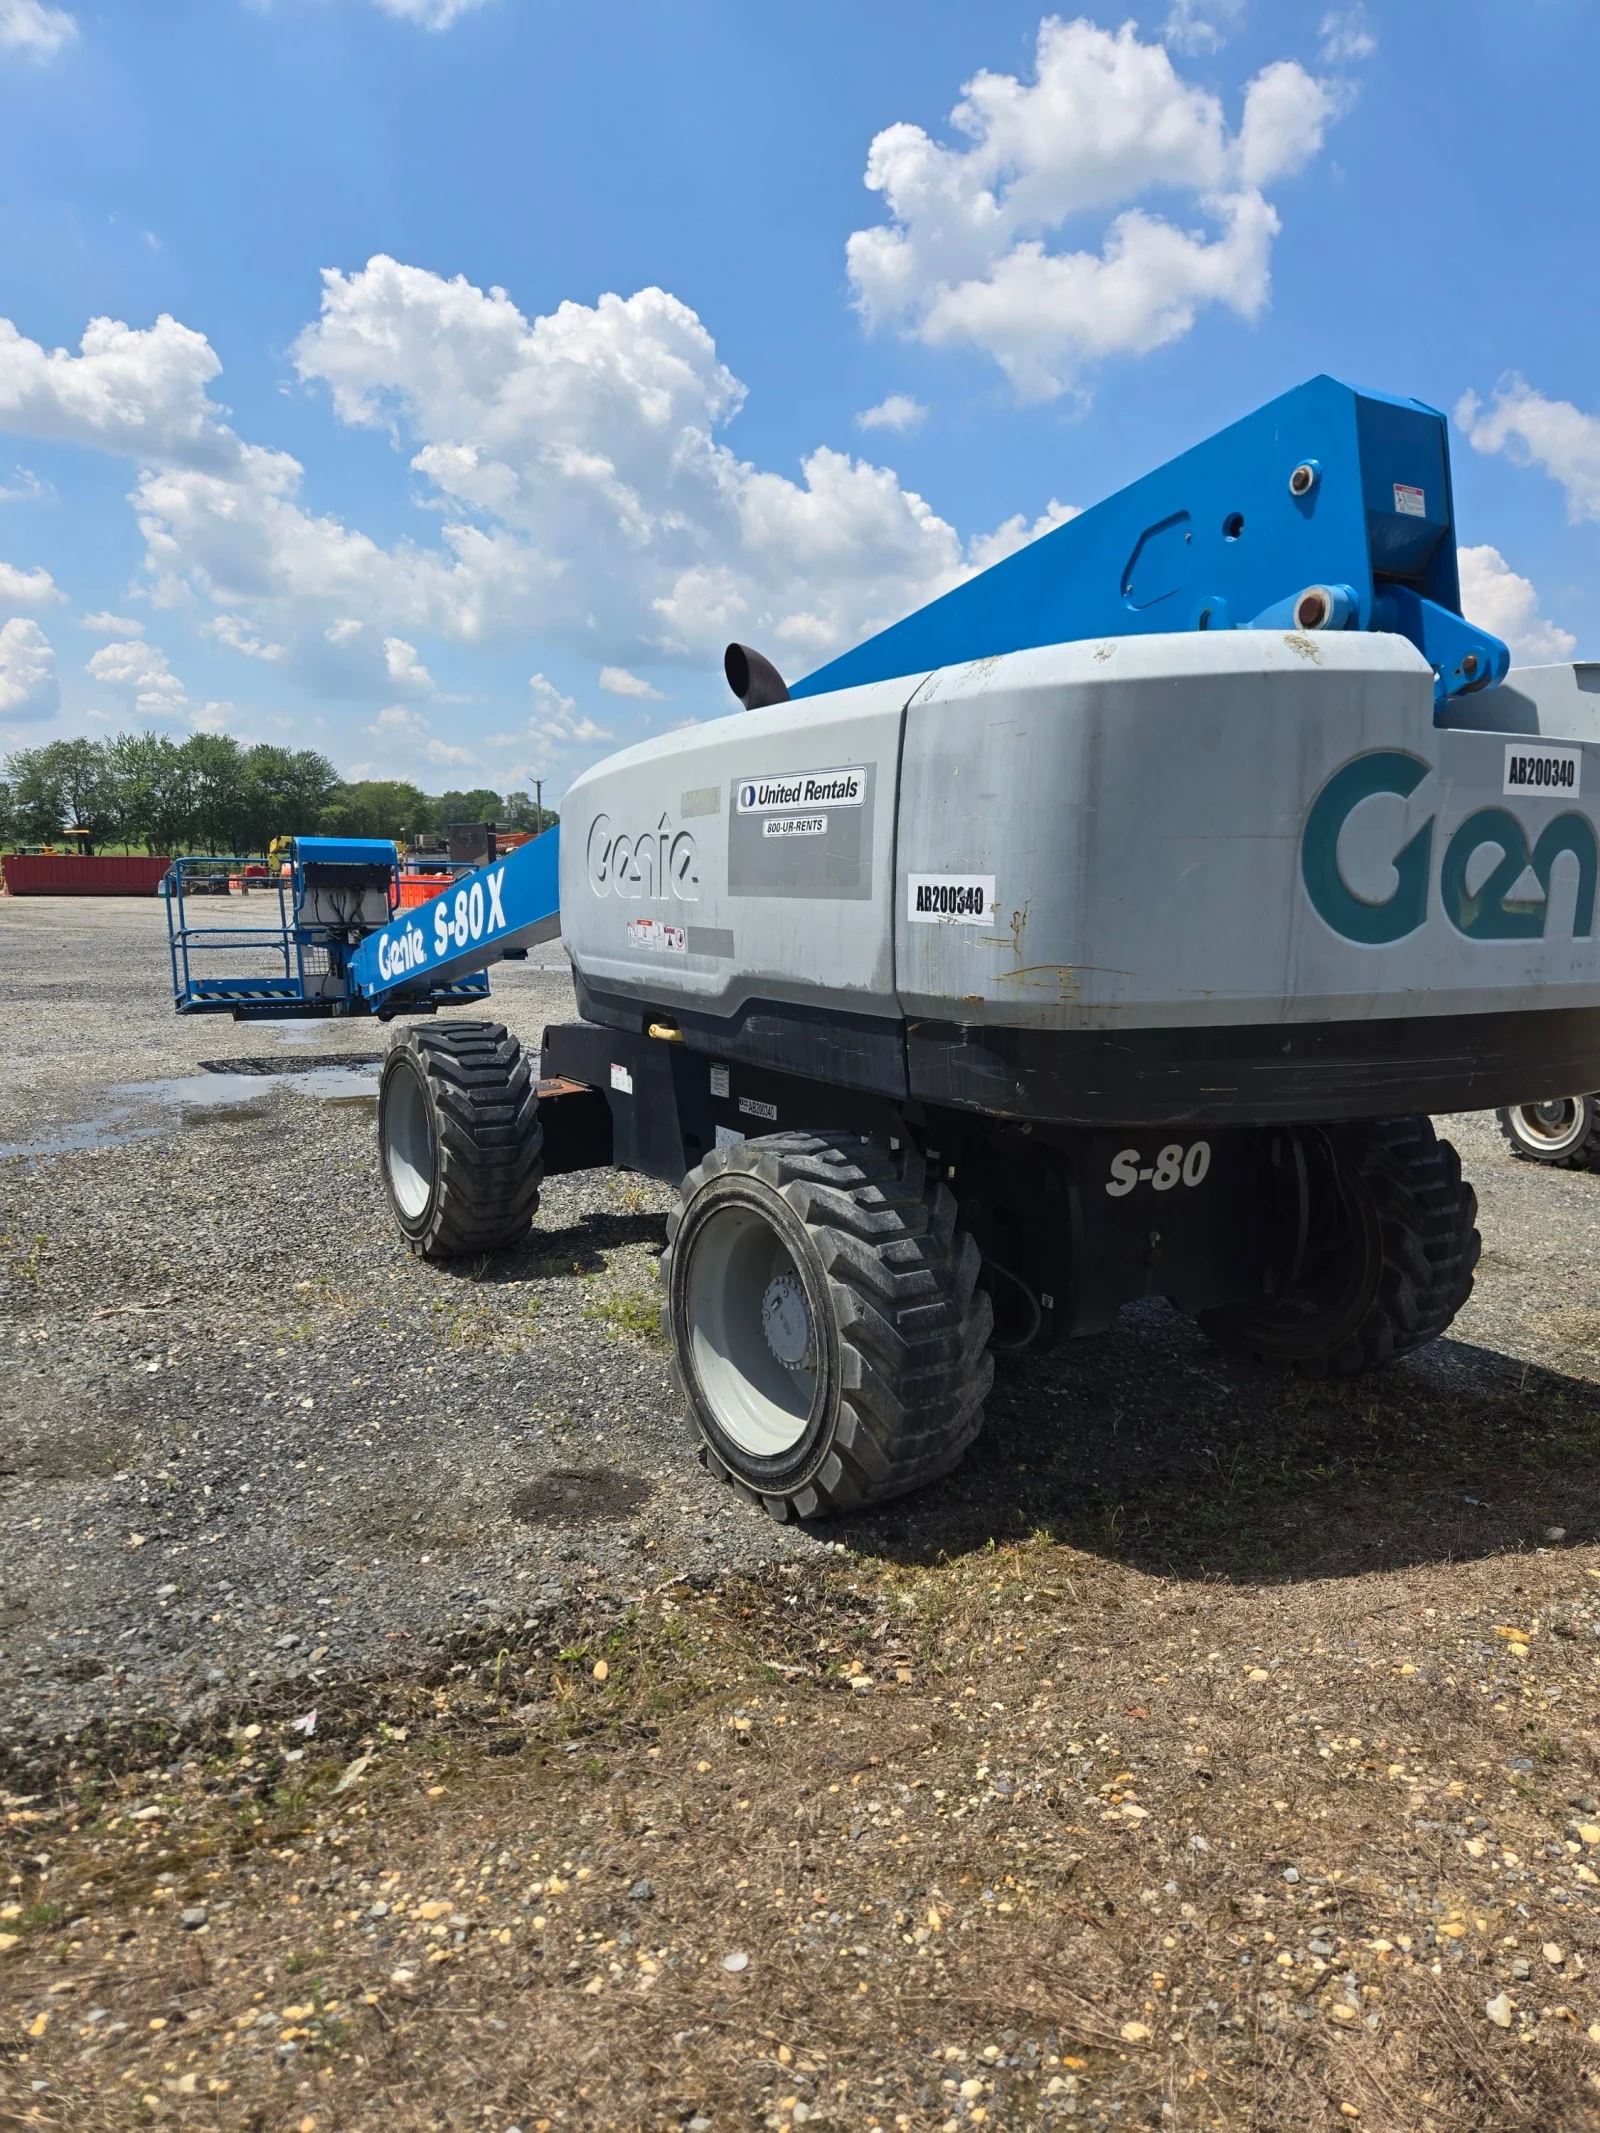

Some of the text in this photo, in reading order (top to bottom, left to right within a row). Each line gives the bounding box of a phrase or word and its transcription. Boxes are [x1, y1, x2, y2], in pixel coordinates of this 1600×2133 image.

[1508, 756, 1575, 788] AB200340
[758, 776, 858, 806] United Rentals
[767, 818, 823, 834] 800-UR-RENTS
[587, 811, 699, 901] Genie
[916, 885, 984, 915] AB200340
[378, 920, 426, 981] Genie
[748, 1100, 774, 1118] AB200340
[1105, 1140, 1212, 1197] S-80
